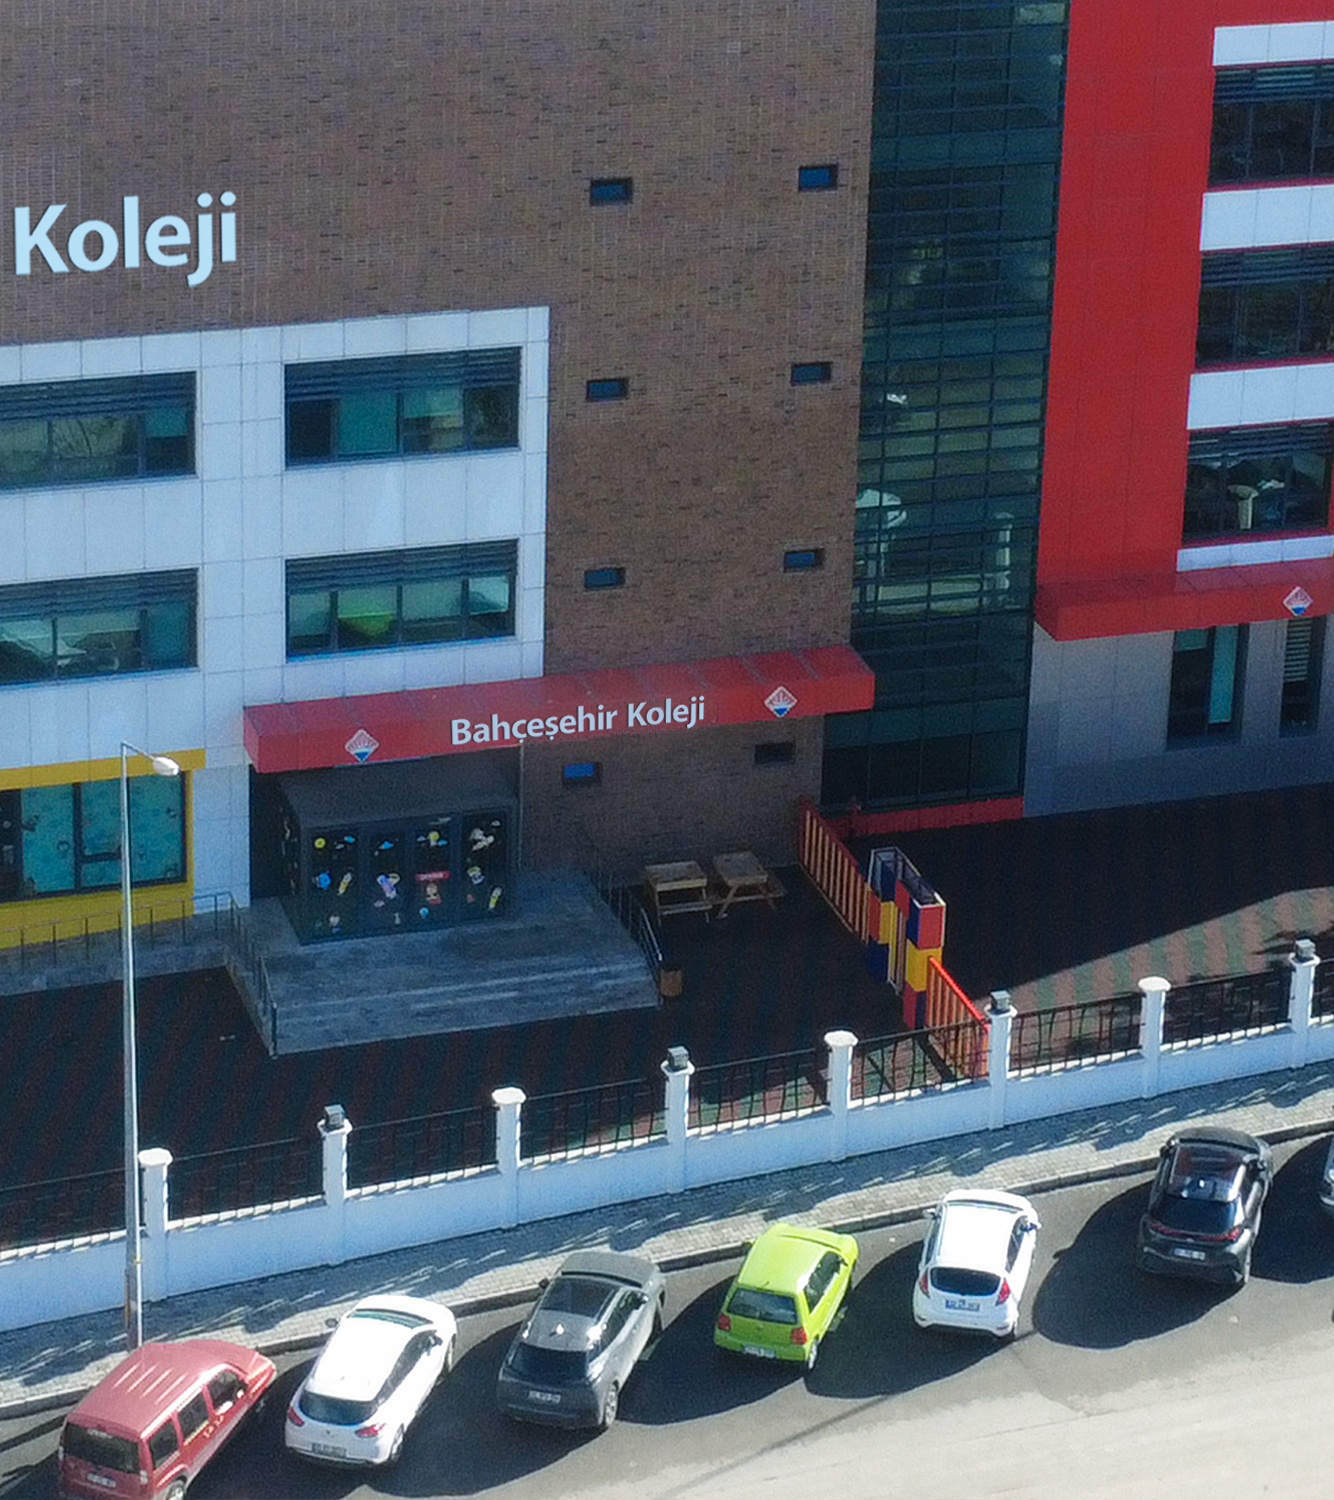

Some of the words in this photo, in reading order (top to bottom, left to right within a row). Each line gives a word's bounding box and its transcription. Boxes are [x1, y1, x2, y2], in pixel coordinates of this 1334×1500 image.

[14, 192, 237, 287] Koleji
[450, 705, 618, 745] Bahçeşehir
[627, 696, 705, 727] Koleji
